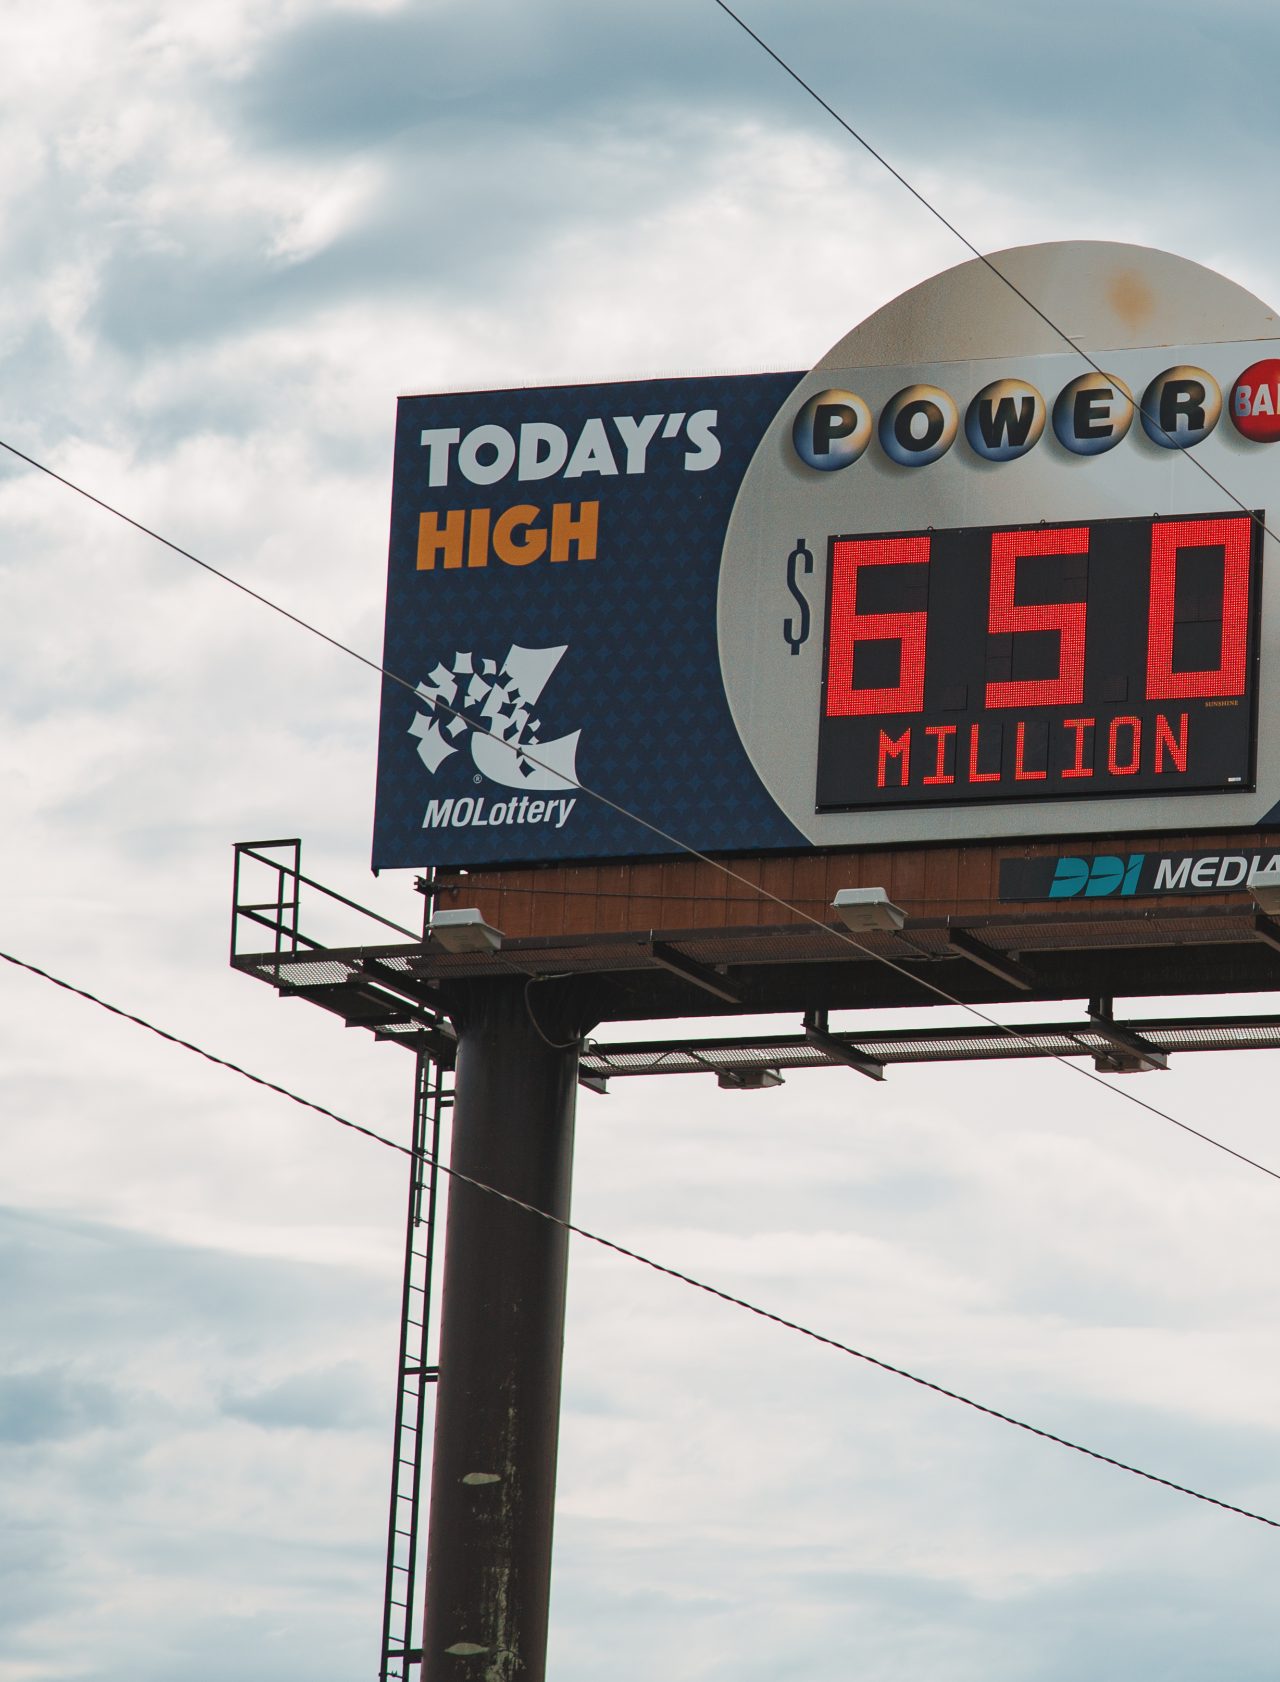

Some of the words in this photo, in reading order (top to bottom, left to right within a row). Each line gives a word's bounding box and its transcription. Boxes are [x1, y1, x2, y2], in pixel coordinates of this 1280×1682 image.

[420, 409, 721, 487] TODAY'S
[416, 501, 600, 571] HIGH
[826, 517, 1252, 717] 650
[877, 713, 1189, 788] MILLION
[422, 797, 577, 829] MOLottery
